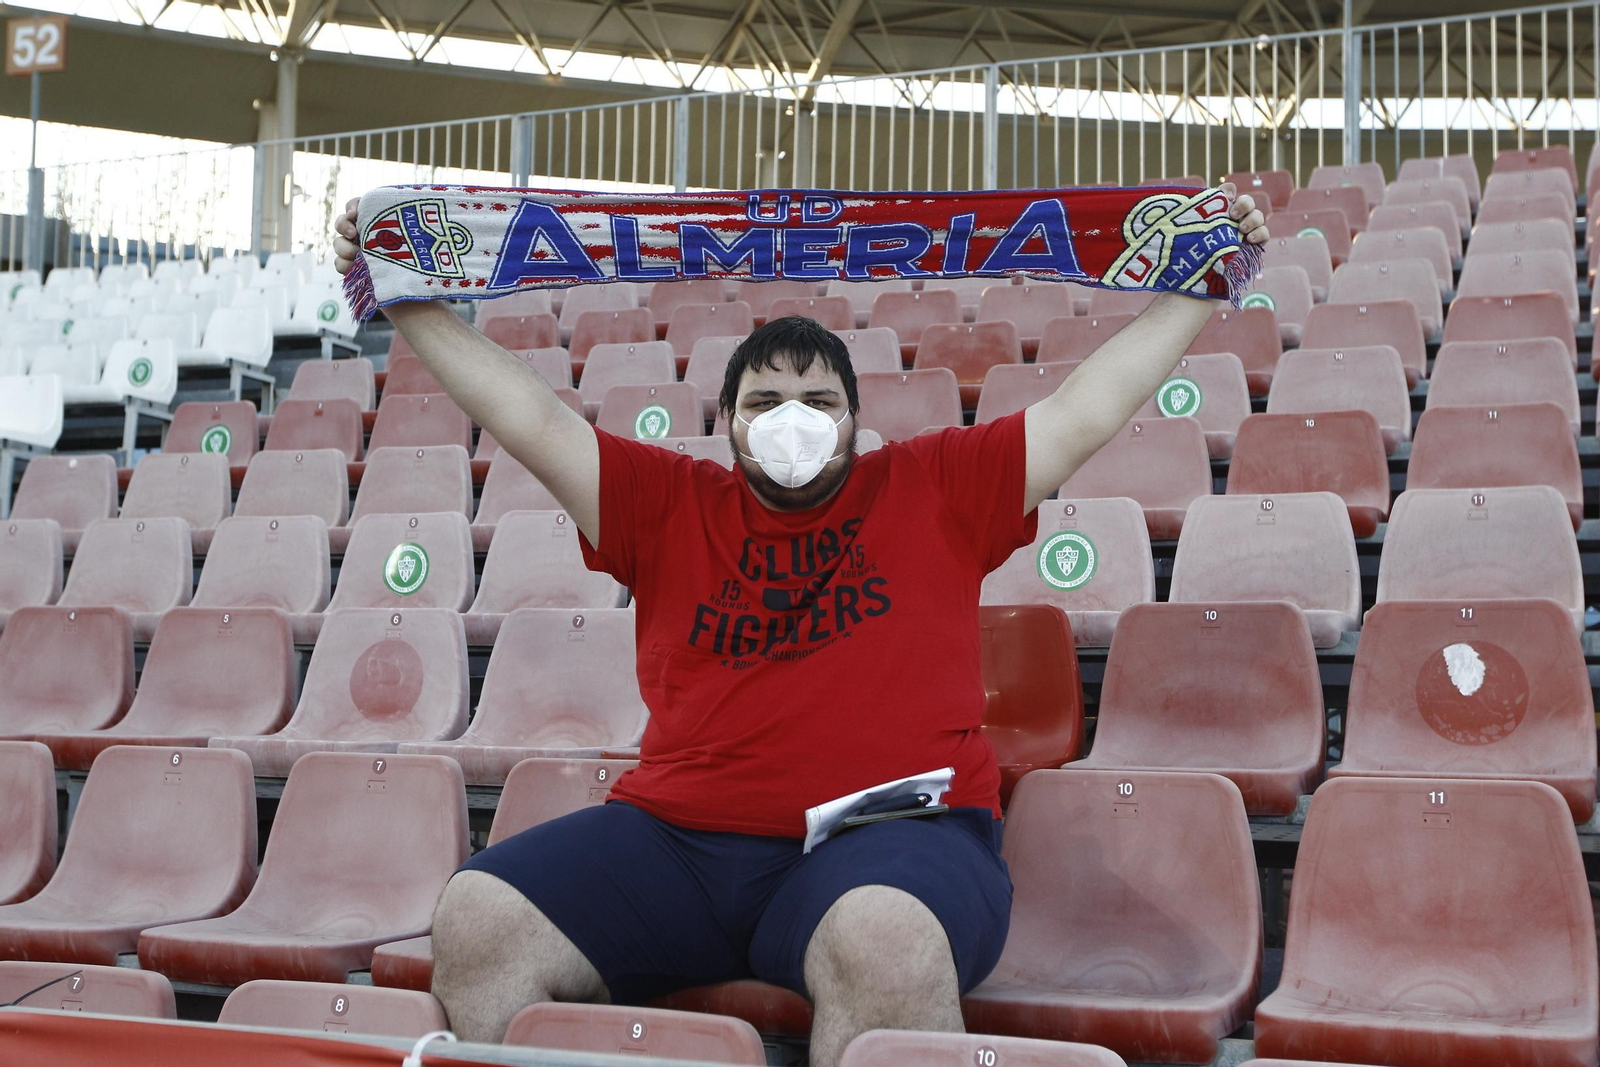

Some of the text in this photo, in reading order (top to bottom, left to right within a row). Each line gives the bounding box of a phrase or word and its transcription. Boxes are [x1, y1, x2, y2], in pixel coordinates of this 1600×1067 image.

[12, 23, 60, 68] 52
[746, 193, 844, 224] UD
[403, 210, 433, 267] ALMERIA
[486, 197, 1088, 290] ALMERIA
[1157, 226, 1237, 289] LMERIA
[1498, 345, 1507, 354] 11
[1334, 352, 1344, 360] 10
[1038, 367, 1045, 376] 8
[901, 374, 908, 382] 7
[1487, 410, 1499, 420] 11
[1304, 418, 1315, 428] 10
[1473, 494, 1484, 505] 11
[1065, 505, 1075, 516] 9
[1261, 500, 1273, 511] 10
[409, 517, 418, 527] 5
[557, 514, 566, 525] 6
[738, 517, 863, 581] CLUBS
[844, 544, 866, 568] 15
[720, 579, 742, 601] 15
[67, 611, 76, 620] 4
[688, 576, 891, 658] FIGHTERS
[1203, 609, 1217, 620] 10
[1459, 606, 1473, 619] 11
[222, 613, 230, 624] 5
[392, 614, 400, 625] 6
[575, 616, 583, 626] 7
[171, 753, 180, 764] 6
[375, 760, 384, 771] 7
[597, 768, 607, 781] 8
[1116, 782, 1133, 796] 10
[1428, 790, 1445, 805] 11
[72, 976, 82, 990] 7
[334, 997, 345, 1013] 8
[631, 1023, 643, 1039] 9
[976, 1048, 997, 1067] 10
